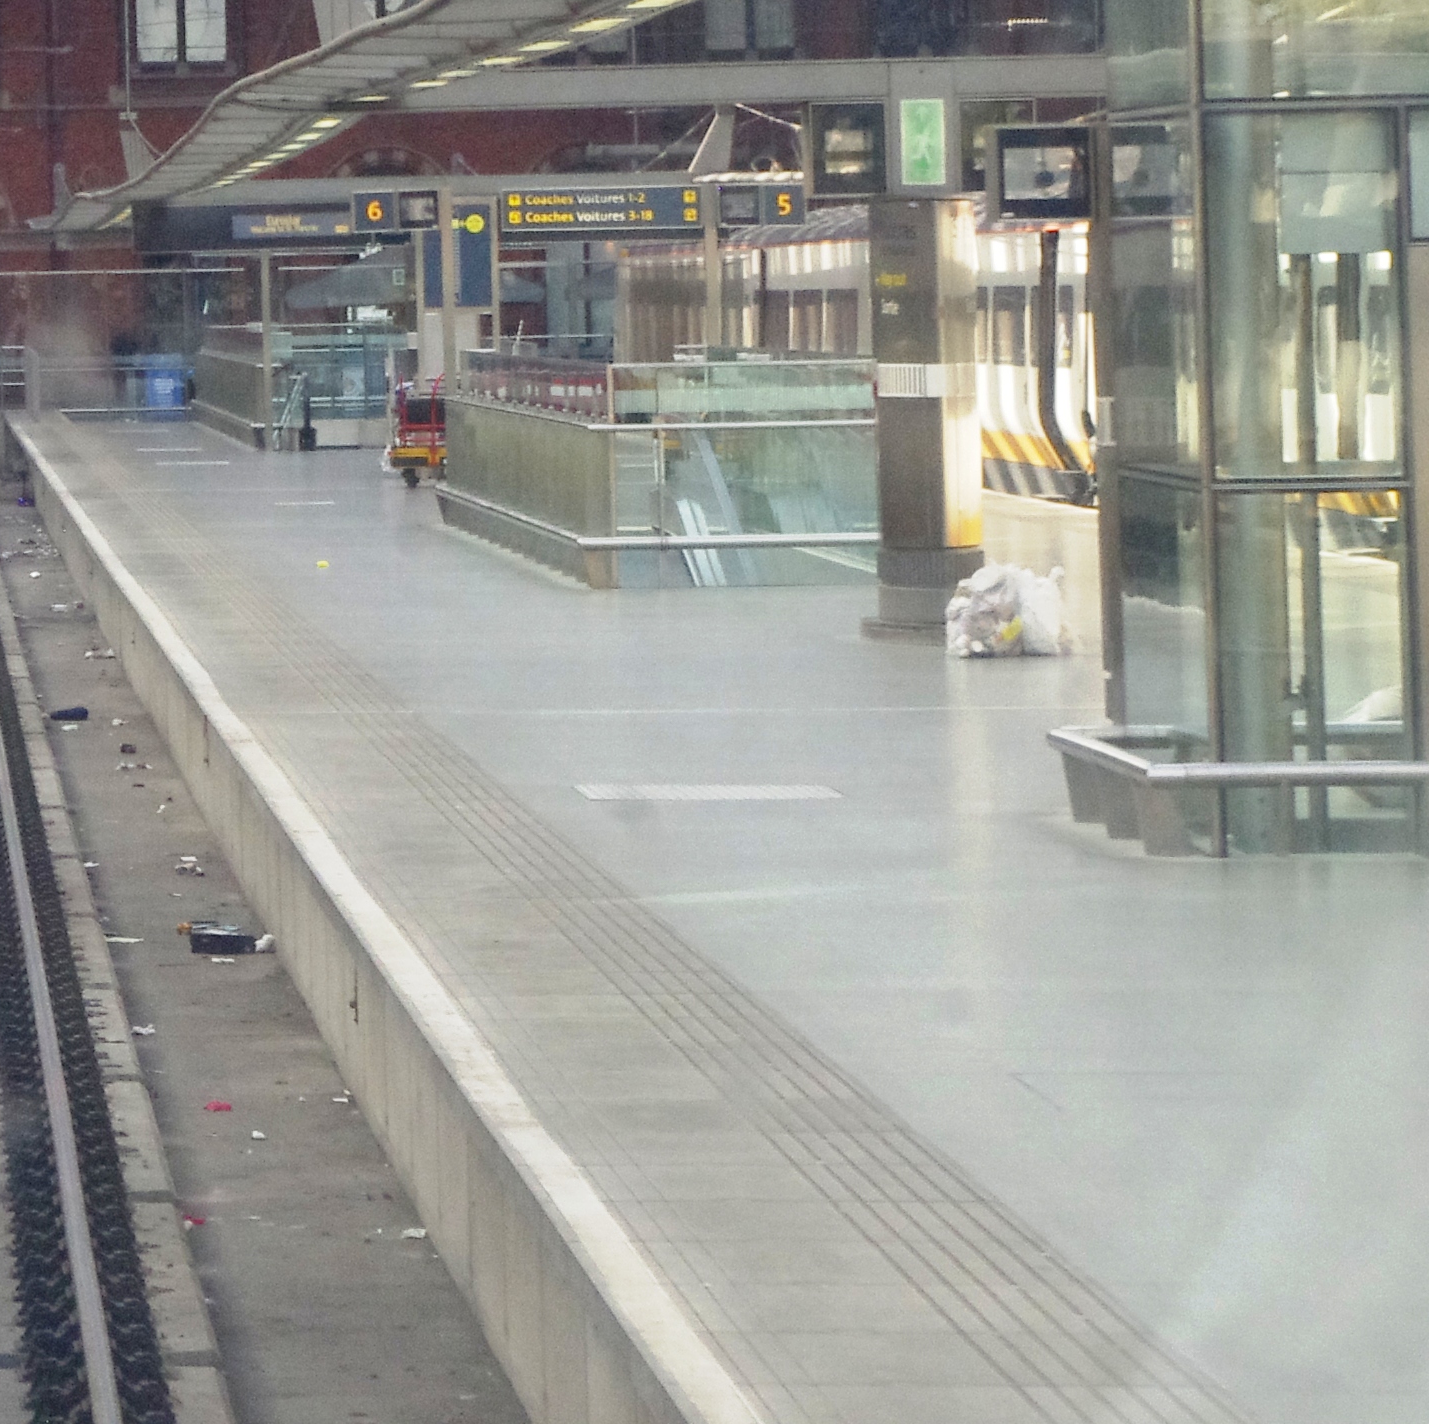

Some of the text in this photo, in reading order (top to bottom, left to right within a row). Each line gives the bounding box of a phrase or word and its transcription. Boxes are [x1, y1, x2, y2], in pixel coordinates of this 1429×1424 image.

[525, 193, 574, 206] Coaches
[576, 192, 625, 205] Voitures
[776, 192, 792, 216] 5
[365, 199, 384, 222] 6
[525, 209, 654, 223] Coaches Voitures 3-18
